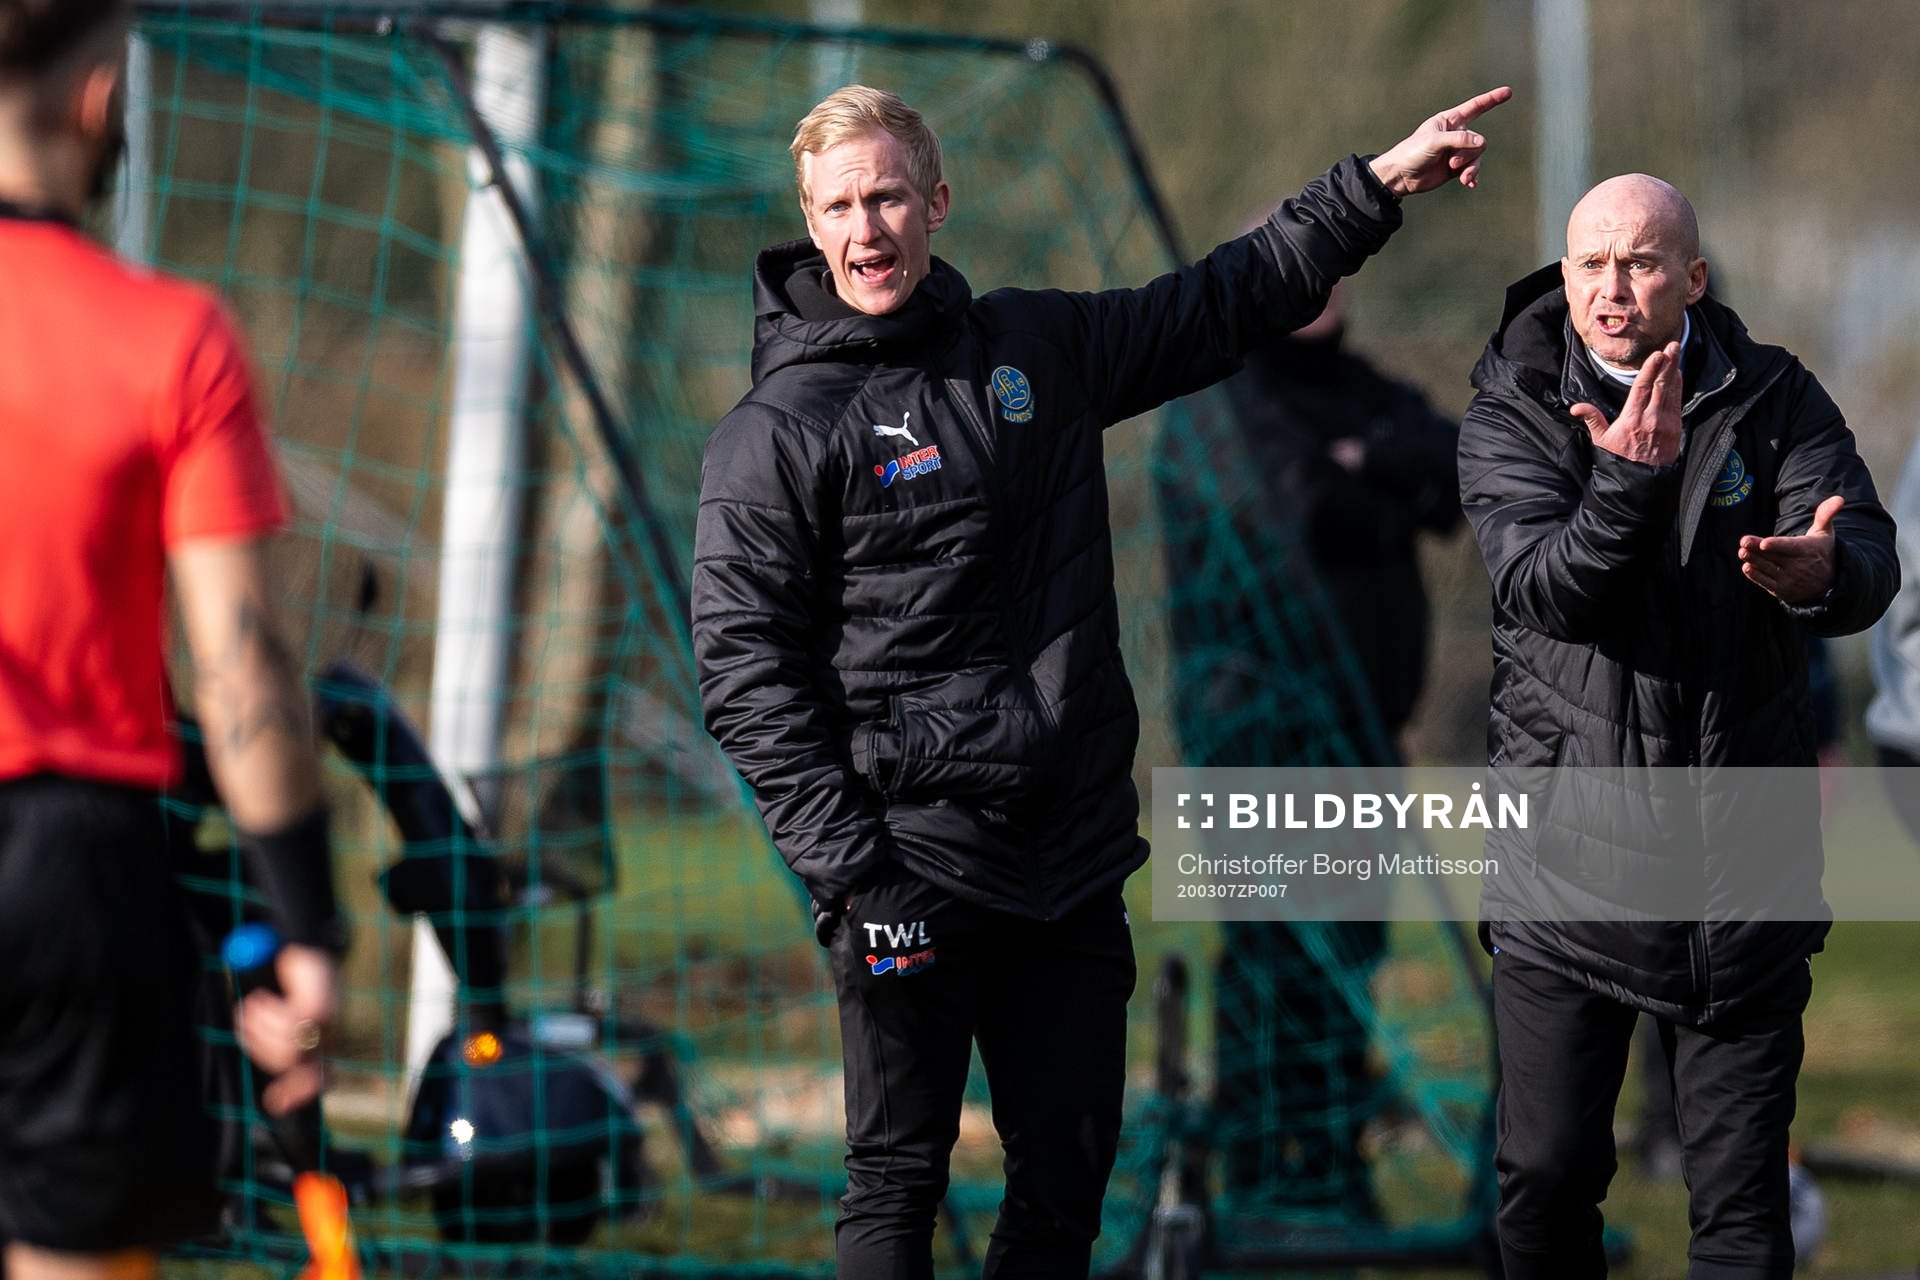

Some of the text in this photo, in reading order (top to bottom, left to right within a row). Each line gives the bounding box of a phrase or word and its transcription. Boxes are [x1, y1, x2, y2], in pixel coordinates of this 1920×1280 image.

[897, 445, 939, 469] INTER
[901, 456, 942, 481] SPORT
[863, 921, 931, 948] TWL
